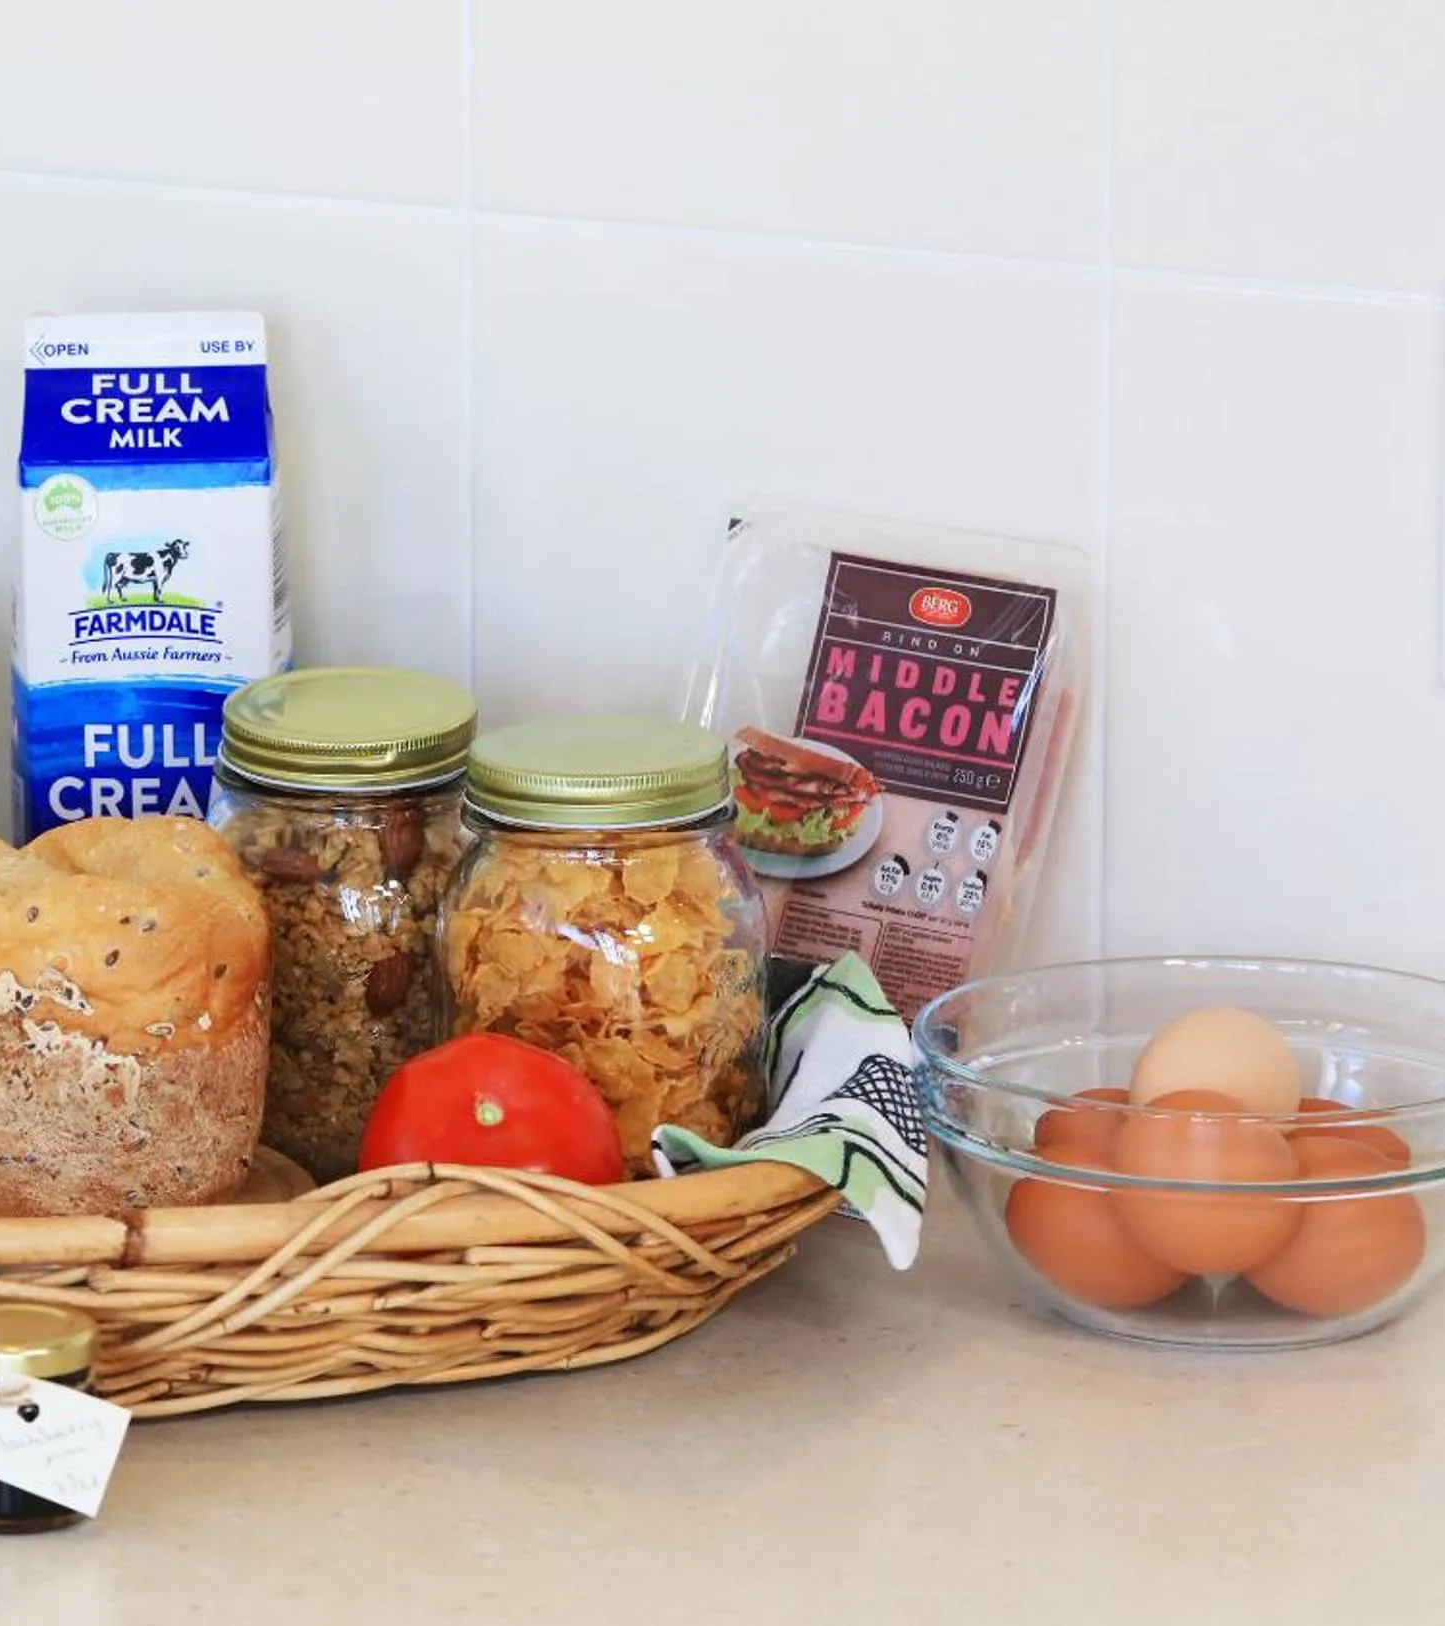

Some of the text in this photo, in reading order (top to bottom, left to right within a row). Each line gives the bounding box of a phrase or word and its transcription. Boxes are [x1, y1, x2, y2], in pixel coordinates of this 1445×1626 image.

[43, 343, 90, 358] OPEN
[200, 340, 255, 354] USE BY
[91, 372, 203, 396] FULL
[60, 396, 230, 425] CREAM
[108, 427, 183, 449] MILK
[74, 610, 217, 639] FARMDALE
[70, 645, 222, 665] From Aussie Farmers
[952, 643, 980, 658] ON
[826, 646, 1021, 708] MIDDLE
[816, 680, 1014, 755] BACON
[83, 722, 216, 769] FULL
[48, 776, 223, 821] CREA
